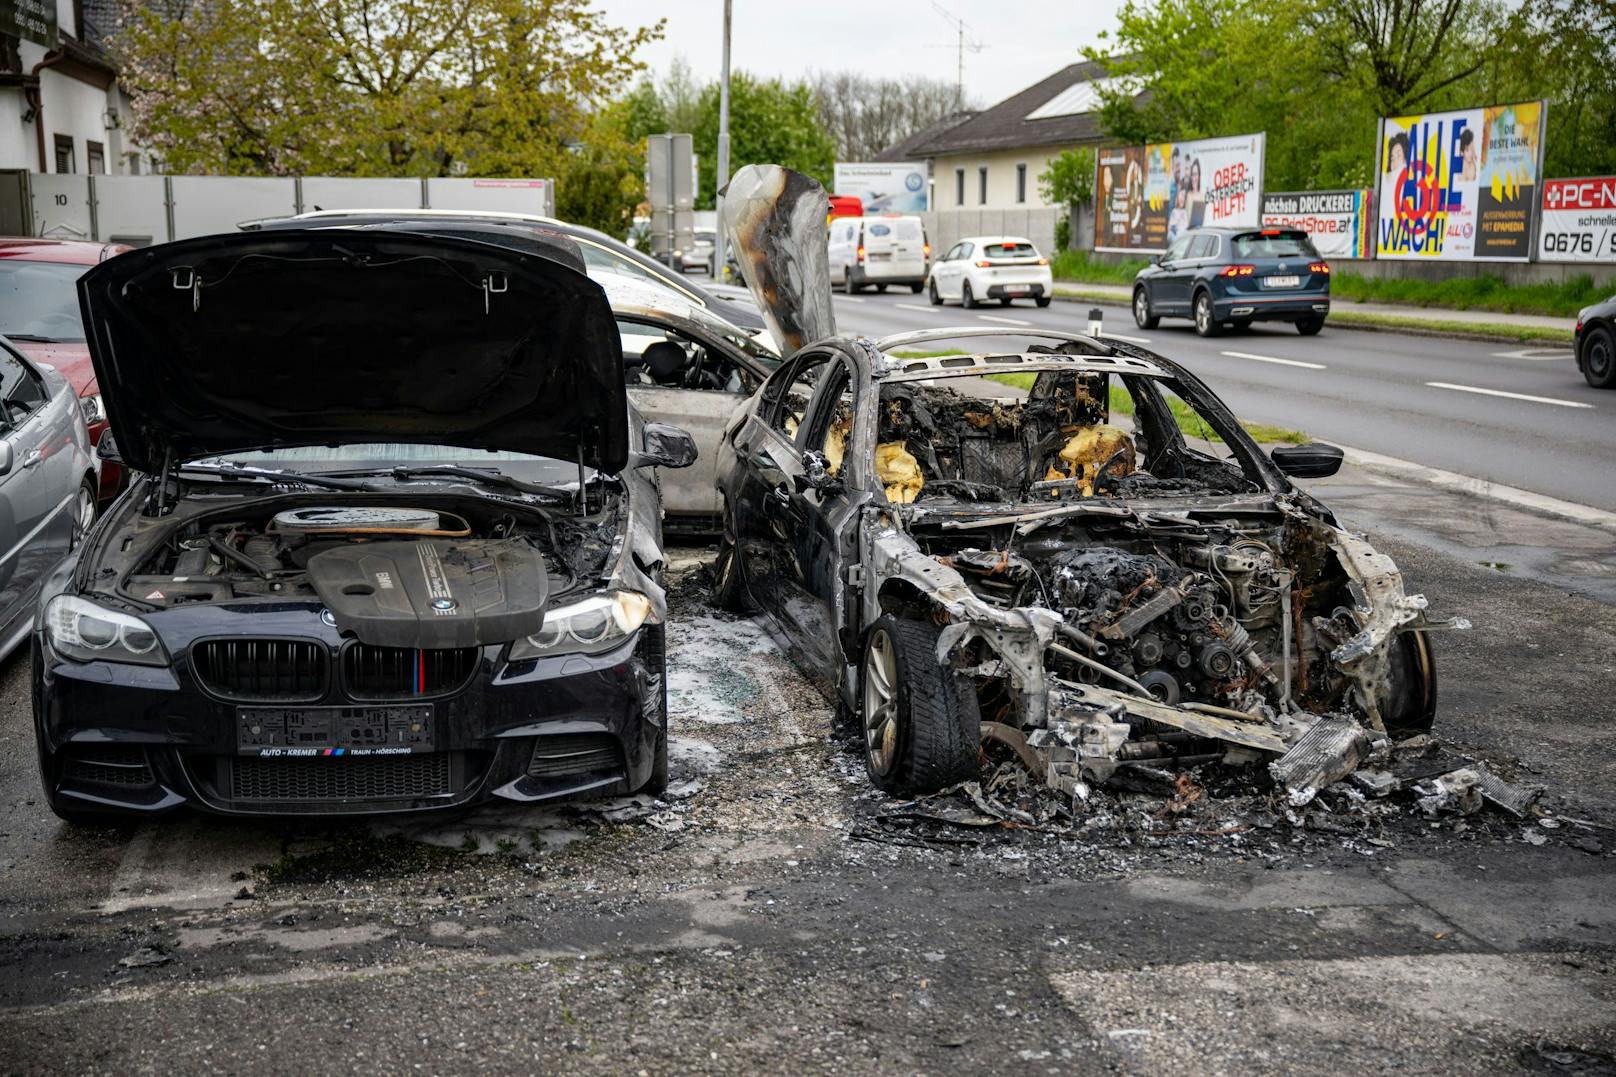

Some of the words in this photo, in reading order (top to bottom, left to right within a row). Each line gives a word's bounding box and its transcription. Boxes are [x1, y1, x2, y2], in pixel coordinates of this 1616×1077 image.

[1504, 124, 1515, 135] DIE
[1400, 118, 1467, 212] ALLE
[1214, 162, 1249, 190] OBER-
[53, 193, 67, 206] 10
[1213, 192, 1246, 220] HILFT!
[1299, 194, 1354, 213] DRUCKEREI
[1382, 217, 1445, 253] WACH!
[1544, 233, 1594, 253] 0676
[375, 572, 394, 589] BMW
[260, 747, 282, 756] AUTO
[287, 748, 318, 756] KREMER
